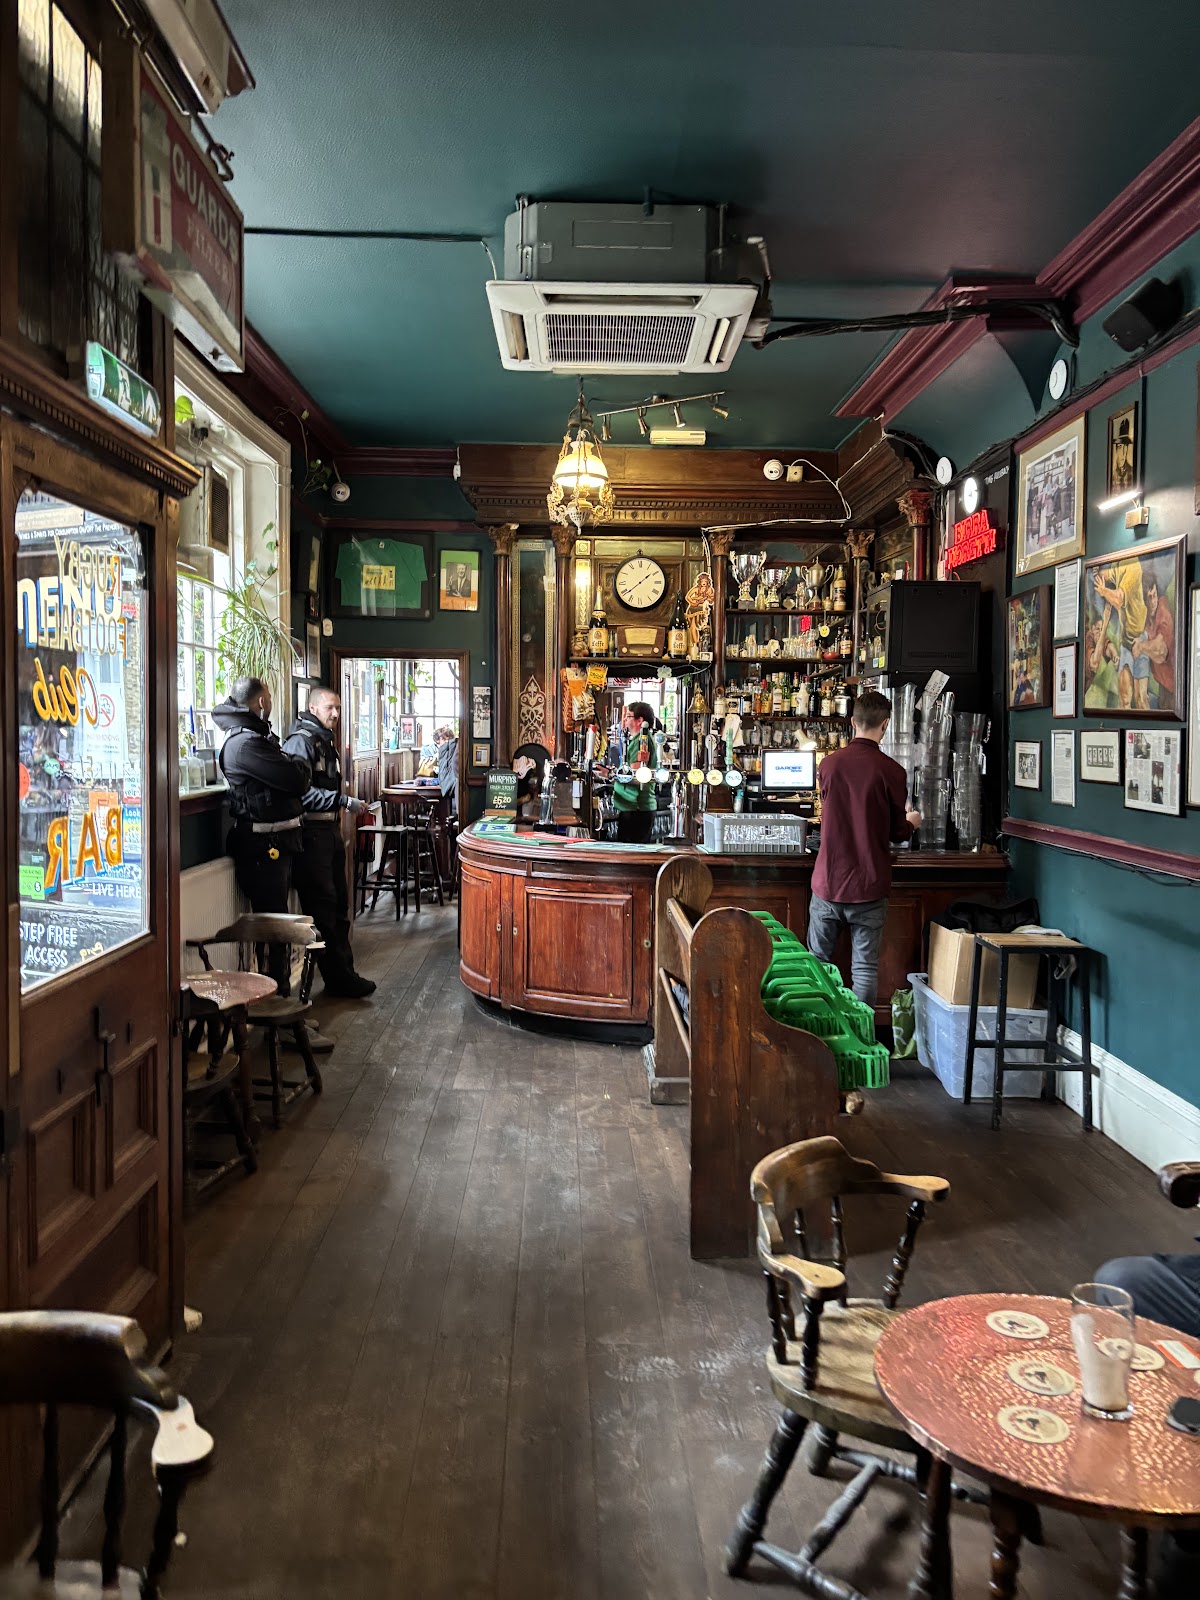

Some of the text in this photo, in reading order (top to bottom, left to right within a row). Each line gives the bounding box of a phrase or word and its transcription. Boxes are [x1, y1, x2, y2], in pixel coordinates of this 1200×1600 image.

[172, 143, 239, 264] GUARDS
[187, 212, 231, 284] FILTER
[954, 509, 990, 546] BIRRA
[488, 774, 517, 784] MURPHYS
[92, 882, 114, 897] LIVE
[19, 920, 78, 946] STEP FREE
[25, 944, 68, 968] ACCESS
